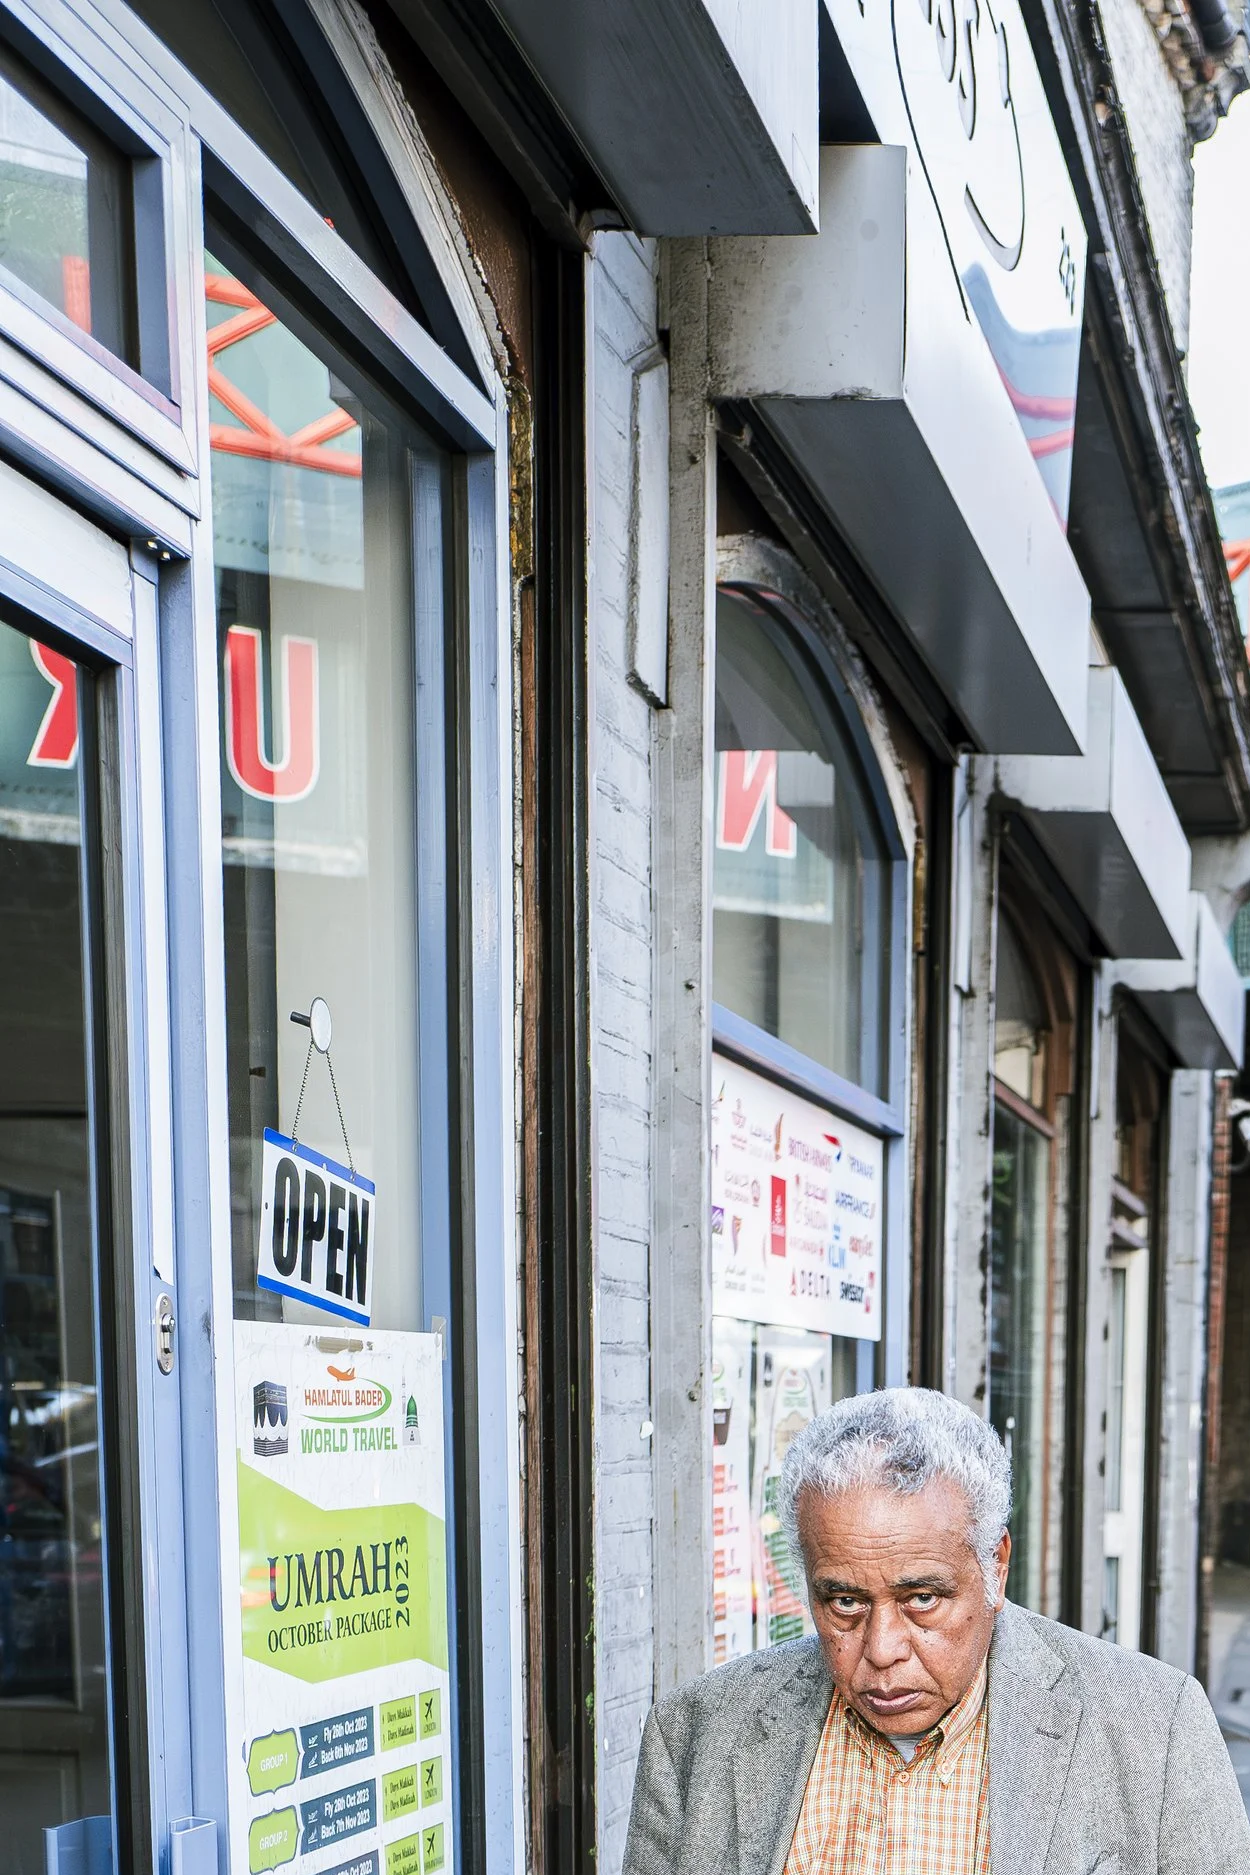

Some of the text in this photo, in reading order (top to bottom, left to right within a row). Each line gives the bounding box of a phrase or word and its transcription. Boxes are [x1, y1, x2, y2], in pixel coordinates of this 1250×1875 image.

[272, 1157, 370, 1306] OPEN
[304, 1389, 383, 1406] HAMLATUL BADER
[301, 1427, 398, 1454] WORLD TRAVEL
[267, 1541, 393, 1612] UMRAH
[395, 1535, 410, 1628] 2023
[268, 1607, 392, 1653] OCTOBER PACKAGE
[324, 1726, 332, 1744] Fly
[345, 1720, 354, 1735] Oct
[355, 1715, 368, 1732] 2023
[260, 1756, 283, 1772] GROUP
[321, 1748, 334, 1765] Back
[344, 1742, 355, 1757] Nov
[355, 1737, 368, 1753] 2023
[324, 1801, 333, 1818] Fly
[346, 1793, 356, 1809] Oct
[357, 1788, 370, 1805] 2023
[321, 1821, 336, 1840] Back
[345, 1815, 357, 1831] Nov
[357, 1808, 370, 1826] 2023
[259, 1833, 283, 1850] GROUP
